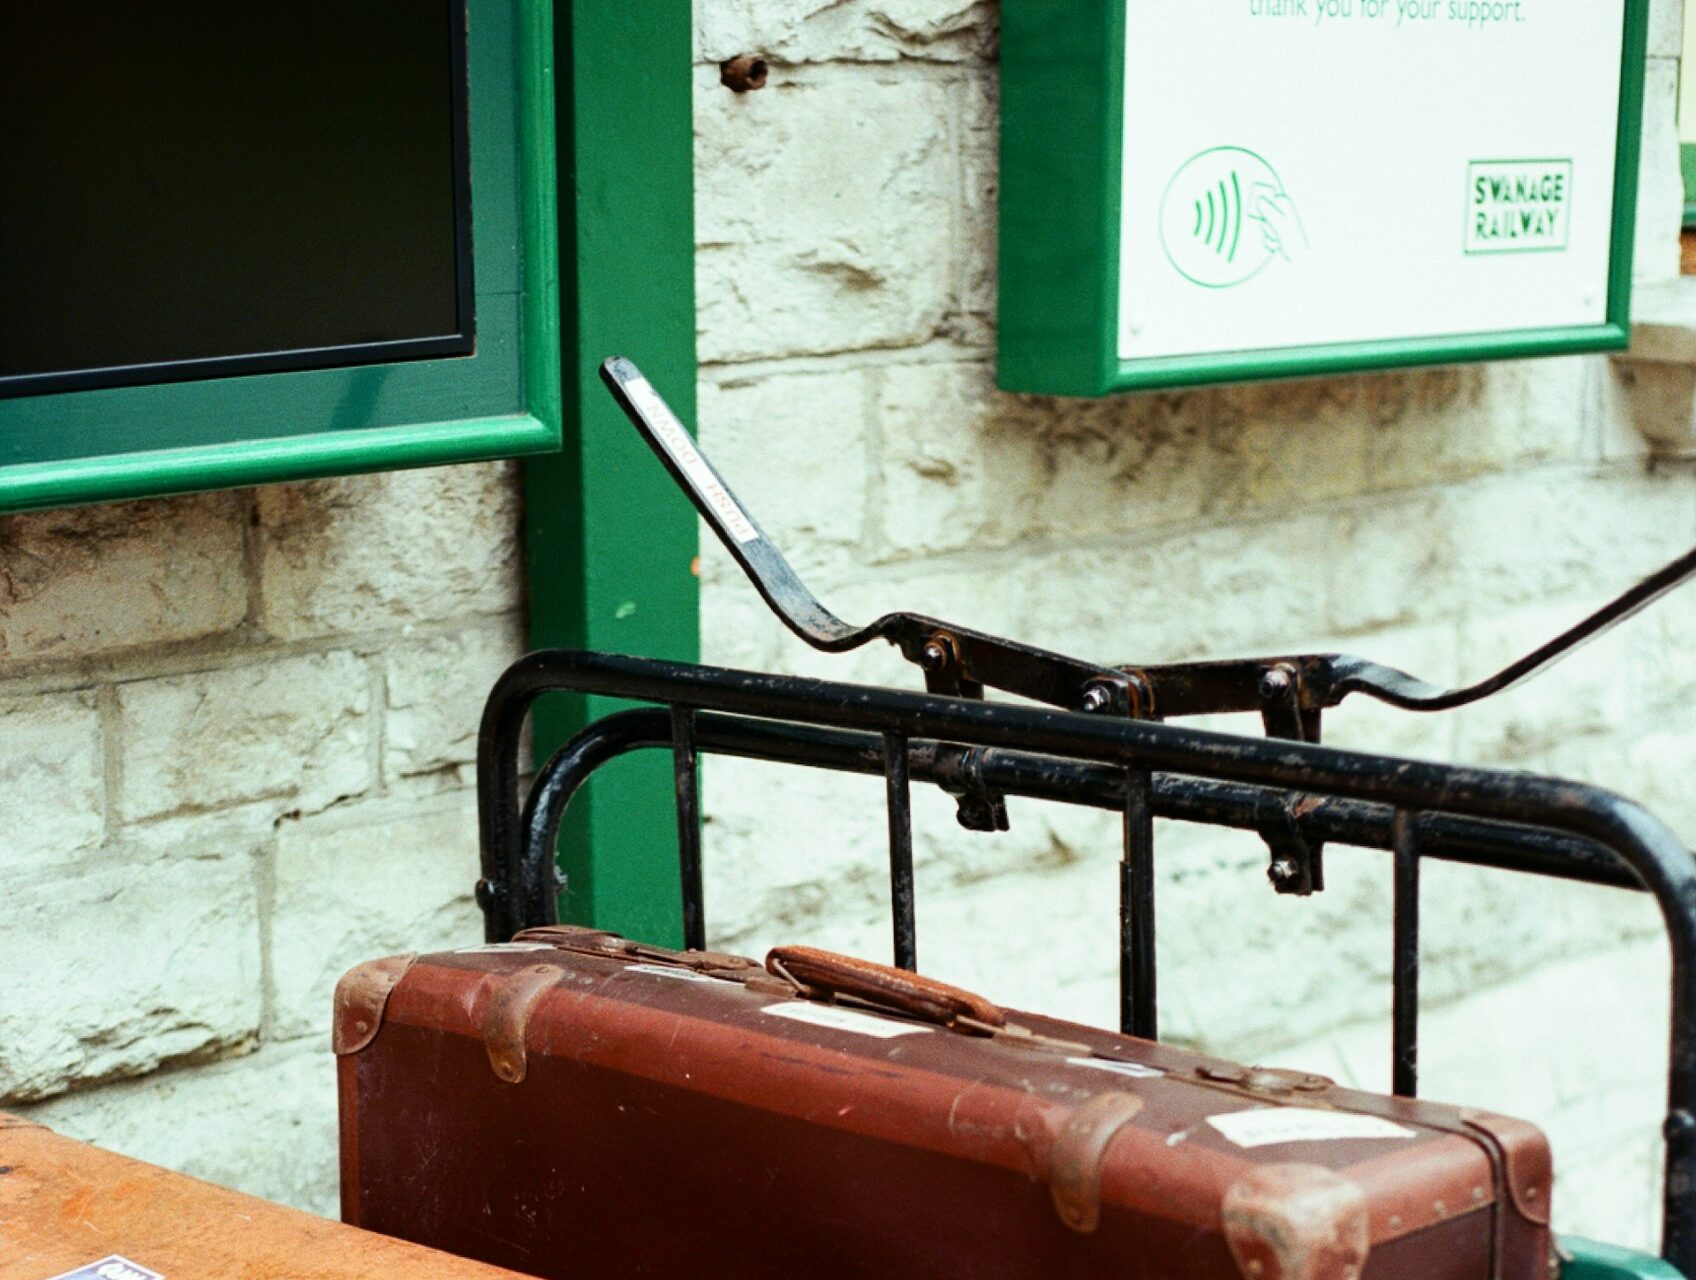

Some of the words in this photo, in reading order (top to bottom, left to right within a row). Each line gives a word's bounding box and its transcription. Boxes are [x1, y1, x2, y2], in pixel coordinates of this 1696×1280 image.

[1315, 0, 1353, 27] you
[1359, 0, 1389, 18] for
[1395, 0, 1442, 28] your
[1448, 0, 1526, 29] support.
[1475, 173, 1564, 205] SWANAGE
[1475, 207, 1559, 239] RAILWAY
[649, 403, 698, 466] DOWN
[705, 483, 751, 536] PUSH
